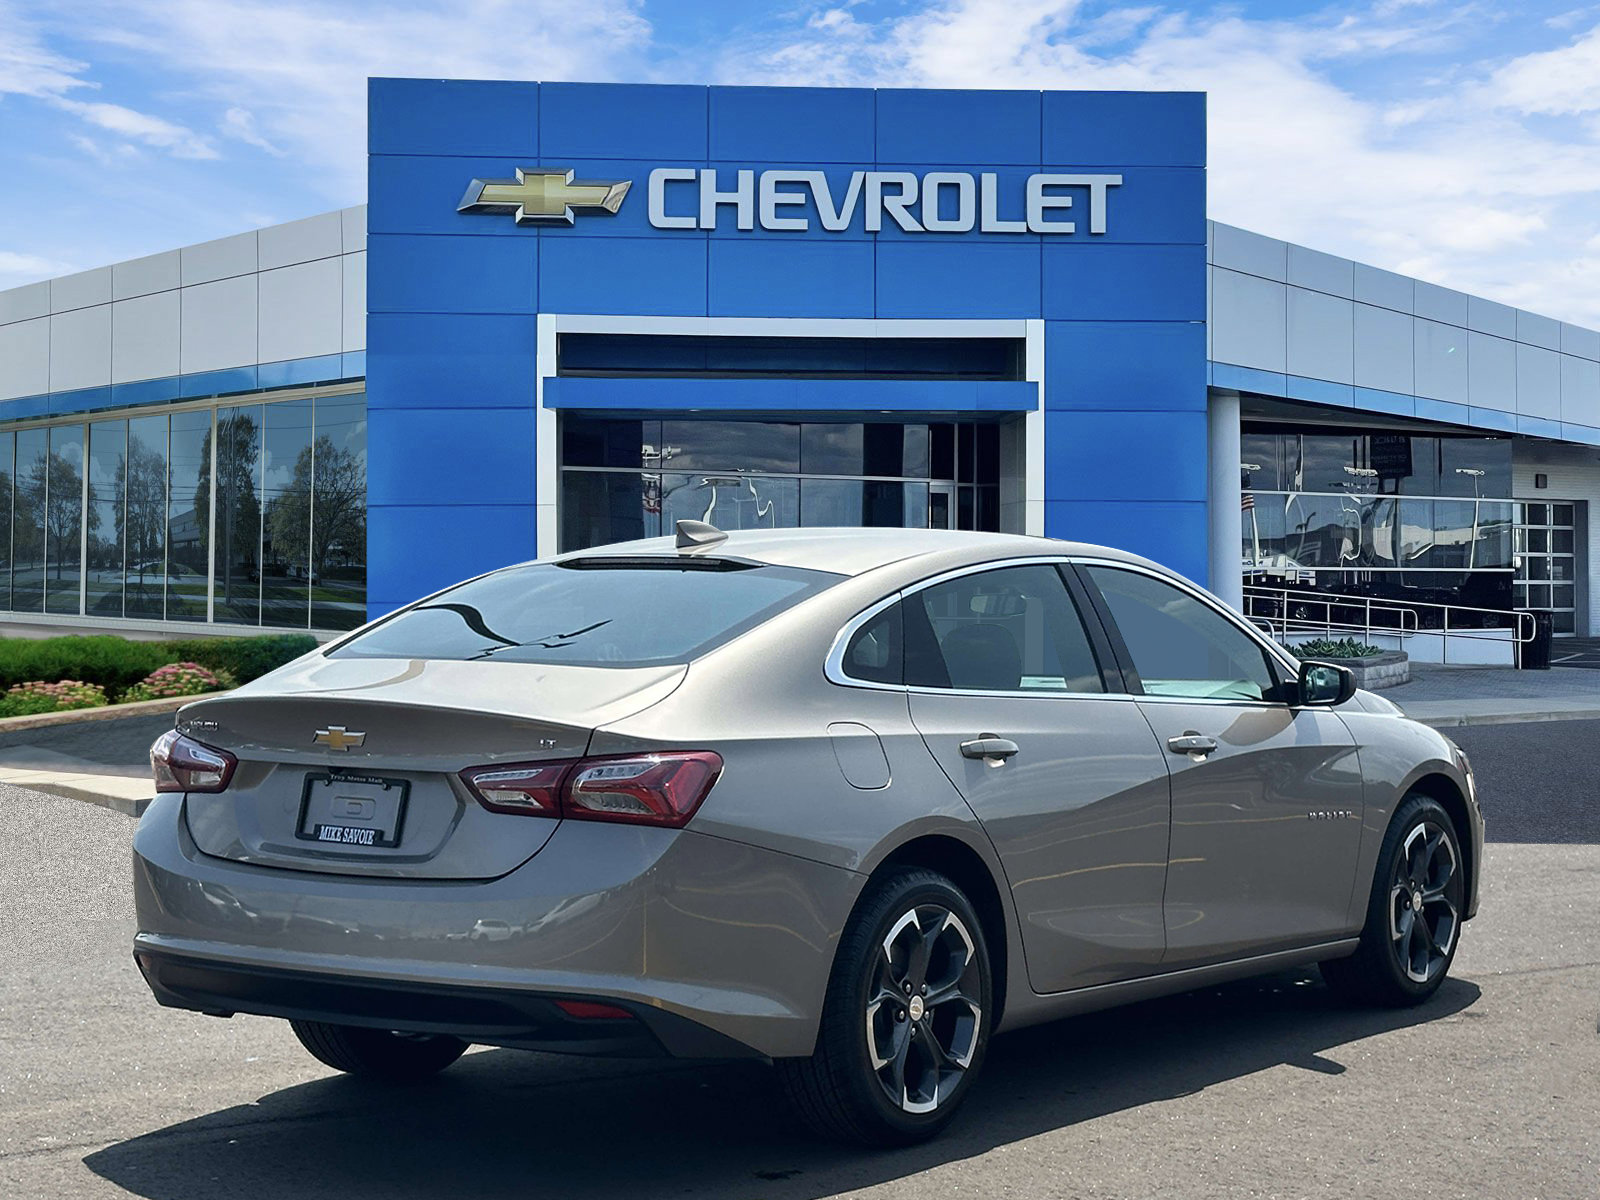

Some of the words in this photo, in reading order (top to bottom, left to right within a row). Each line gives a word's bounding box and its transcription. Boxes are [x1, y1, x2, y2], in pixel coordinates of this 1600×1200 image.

[648, 167, 1123, 235] CHEVROLET
[319, 825, 342, 842] MIKE
[342, 827, 375, 845] SAVOIE
